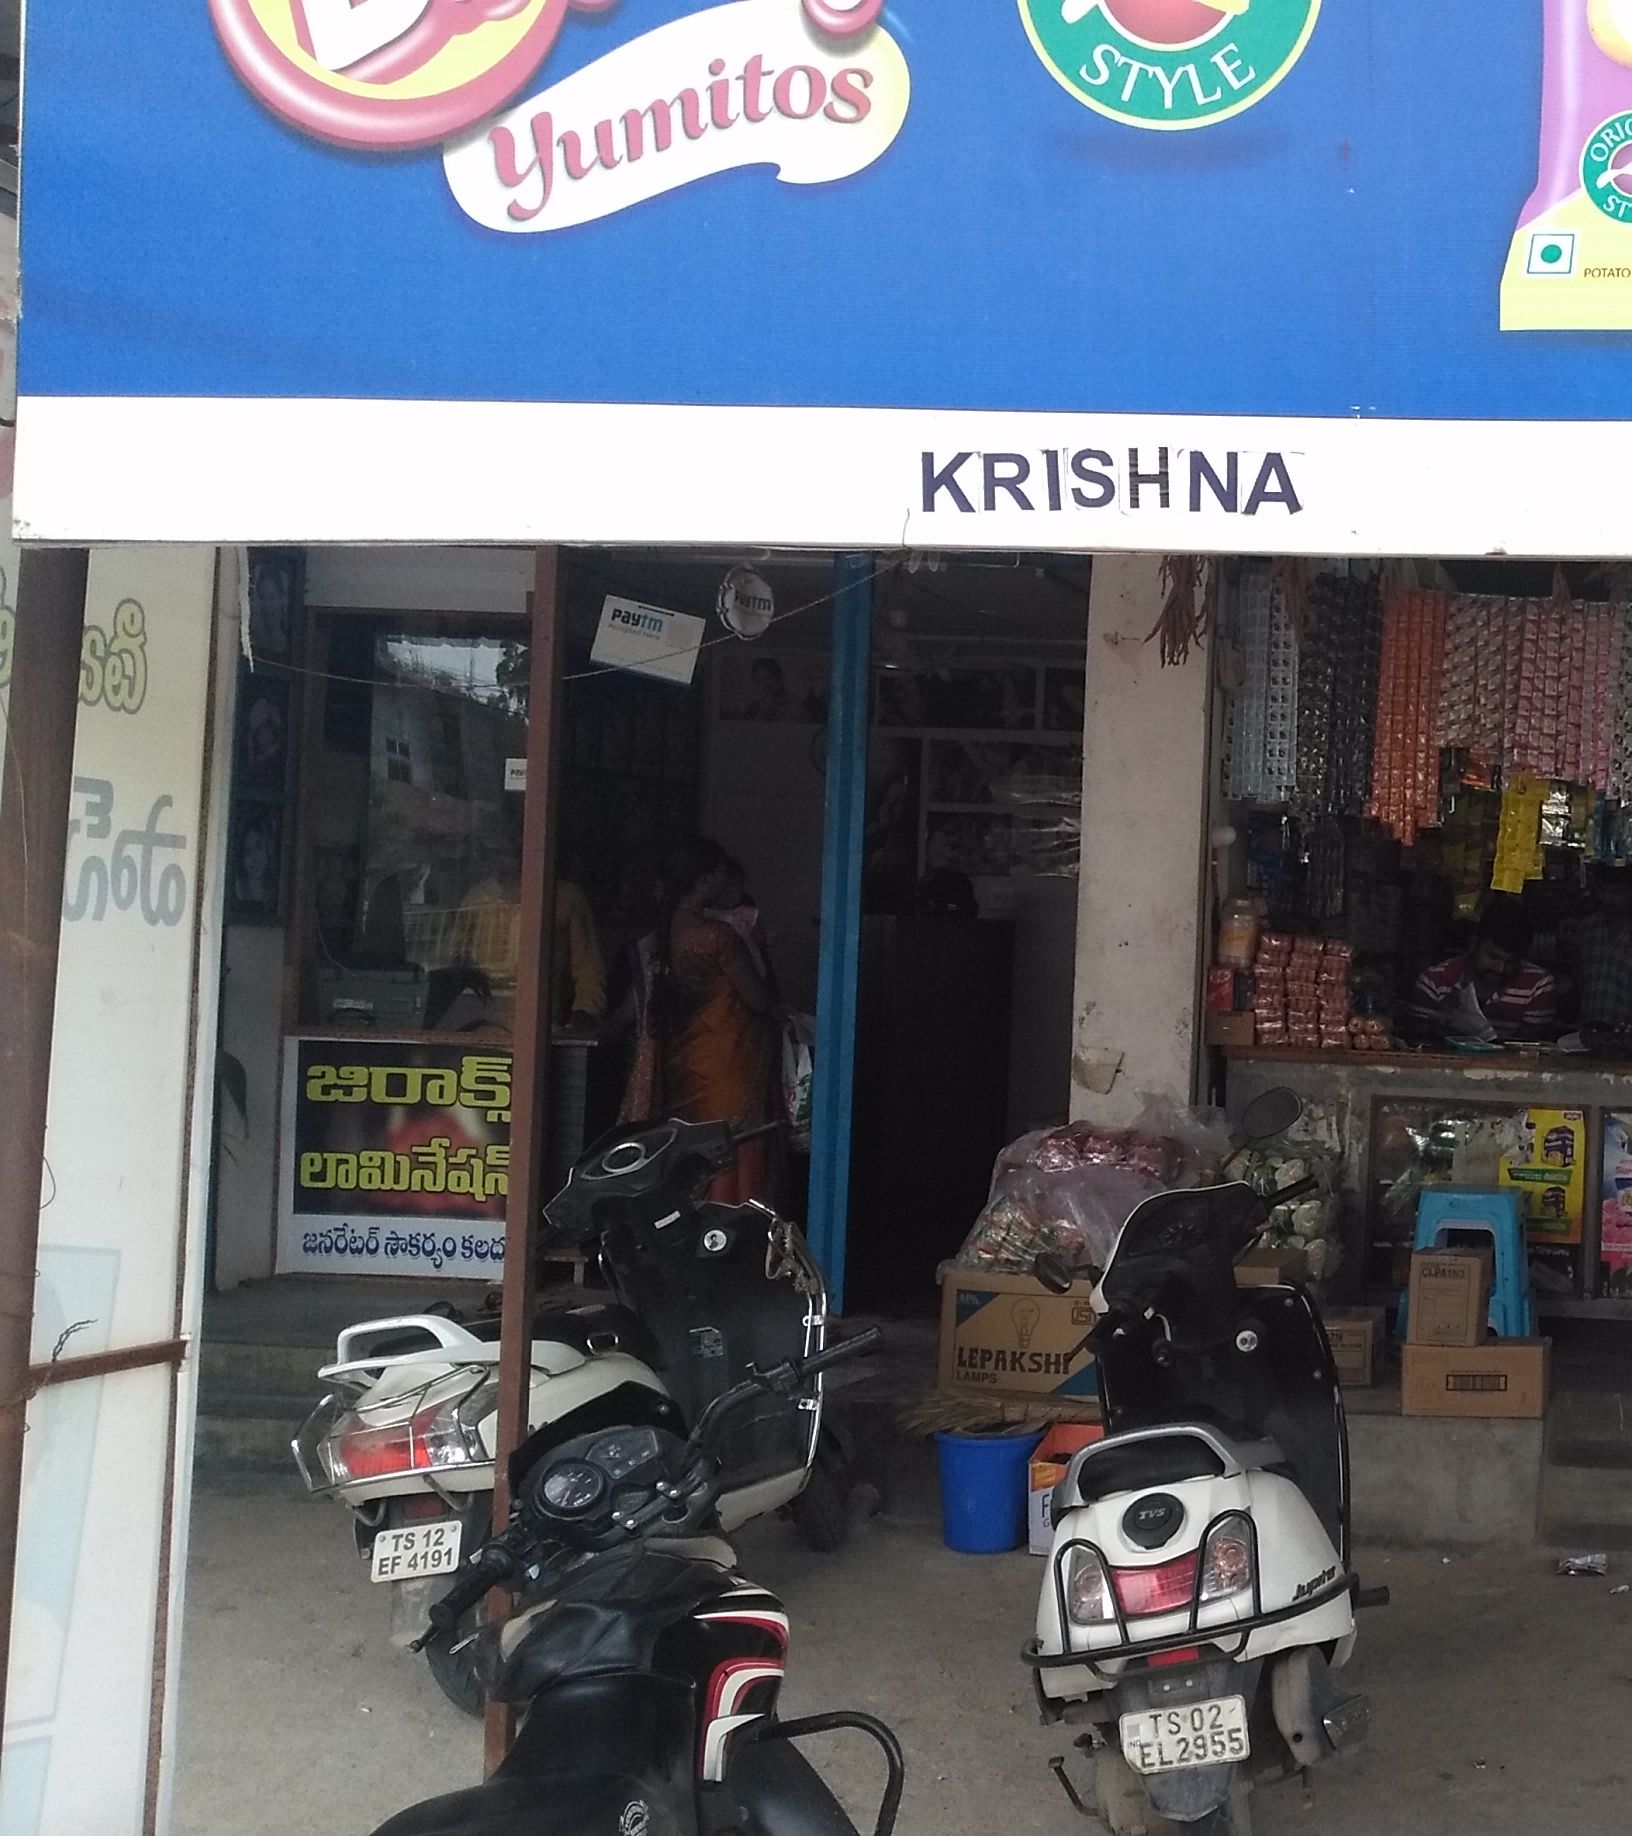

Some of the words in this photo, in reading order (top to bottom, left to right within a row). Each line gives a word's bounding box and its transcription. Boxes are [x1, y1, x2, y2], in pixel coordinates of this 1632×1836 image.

[1079, 41, 1258, 110] STYLE
[487, 54, 874, 221] Yumitos
[1584, 266, 1632, 279] POTATO
[920, 446, 1304, 516] KRISHNA
[956, 1371, 998, 1384] LAMPS
[1139, 1506, 1166, 1520] TVS
[392, 1533, 416, 1552] TS
[422, 1528, 445, 1548] 12
[378, 1555, 402, 1576] EF
[407, 1547, 454, 1571] 4191
[1149, 1711, 1181, 1739] TS
[1190, 1704, 1223, 1733] 02
